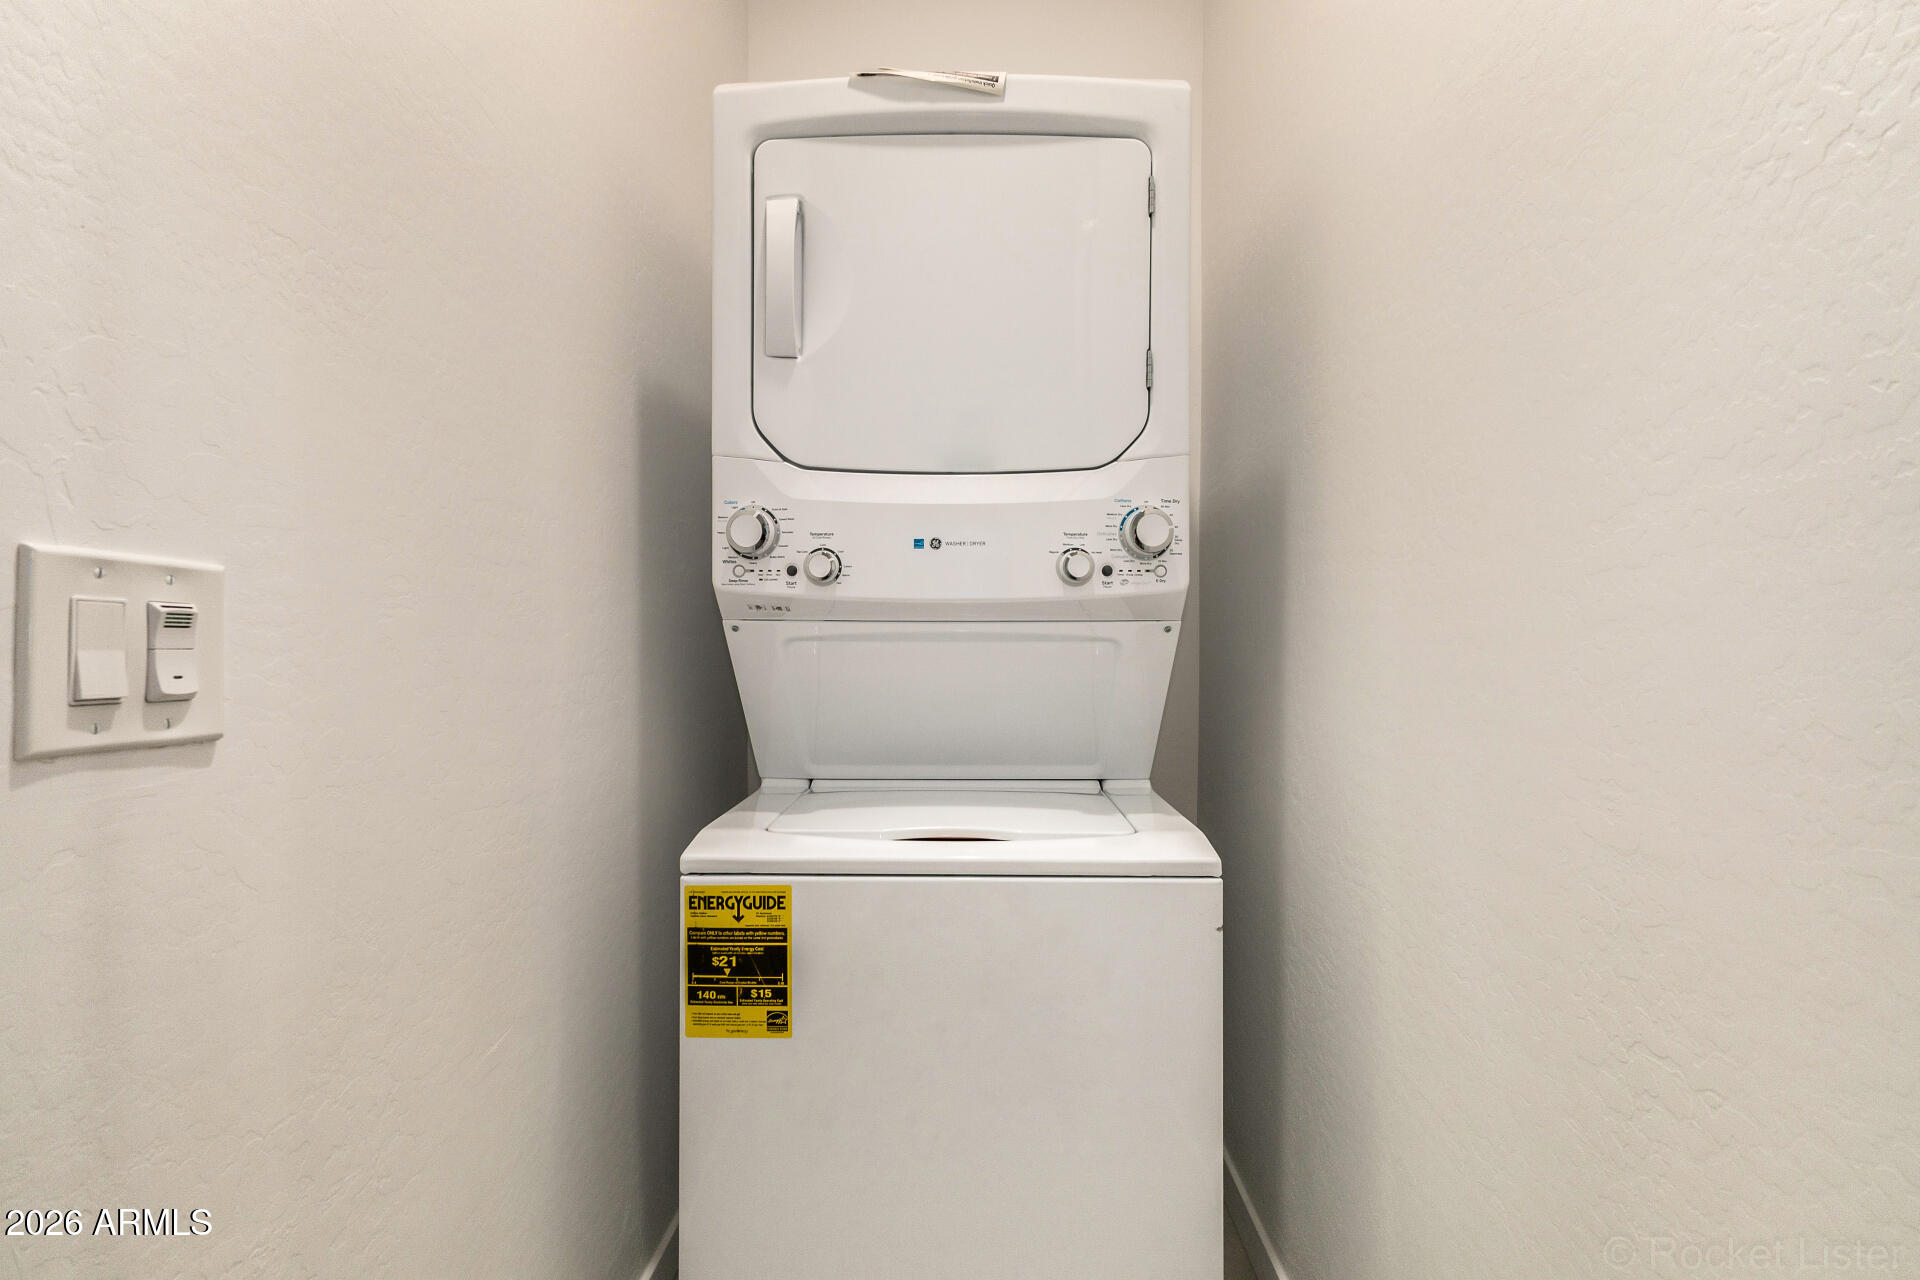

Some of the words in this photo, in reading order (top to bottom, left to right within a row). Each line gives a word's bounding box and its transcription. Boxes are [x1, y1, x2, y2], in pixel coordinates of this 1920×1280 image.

[688, 895, 786, 911] ENERGYGUIDE
[711, 955, 737, 968] $21
[696, 990, 717, 1000] 140
[750, 989, 772, 998] $15
